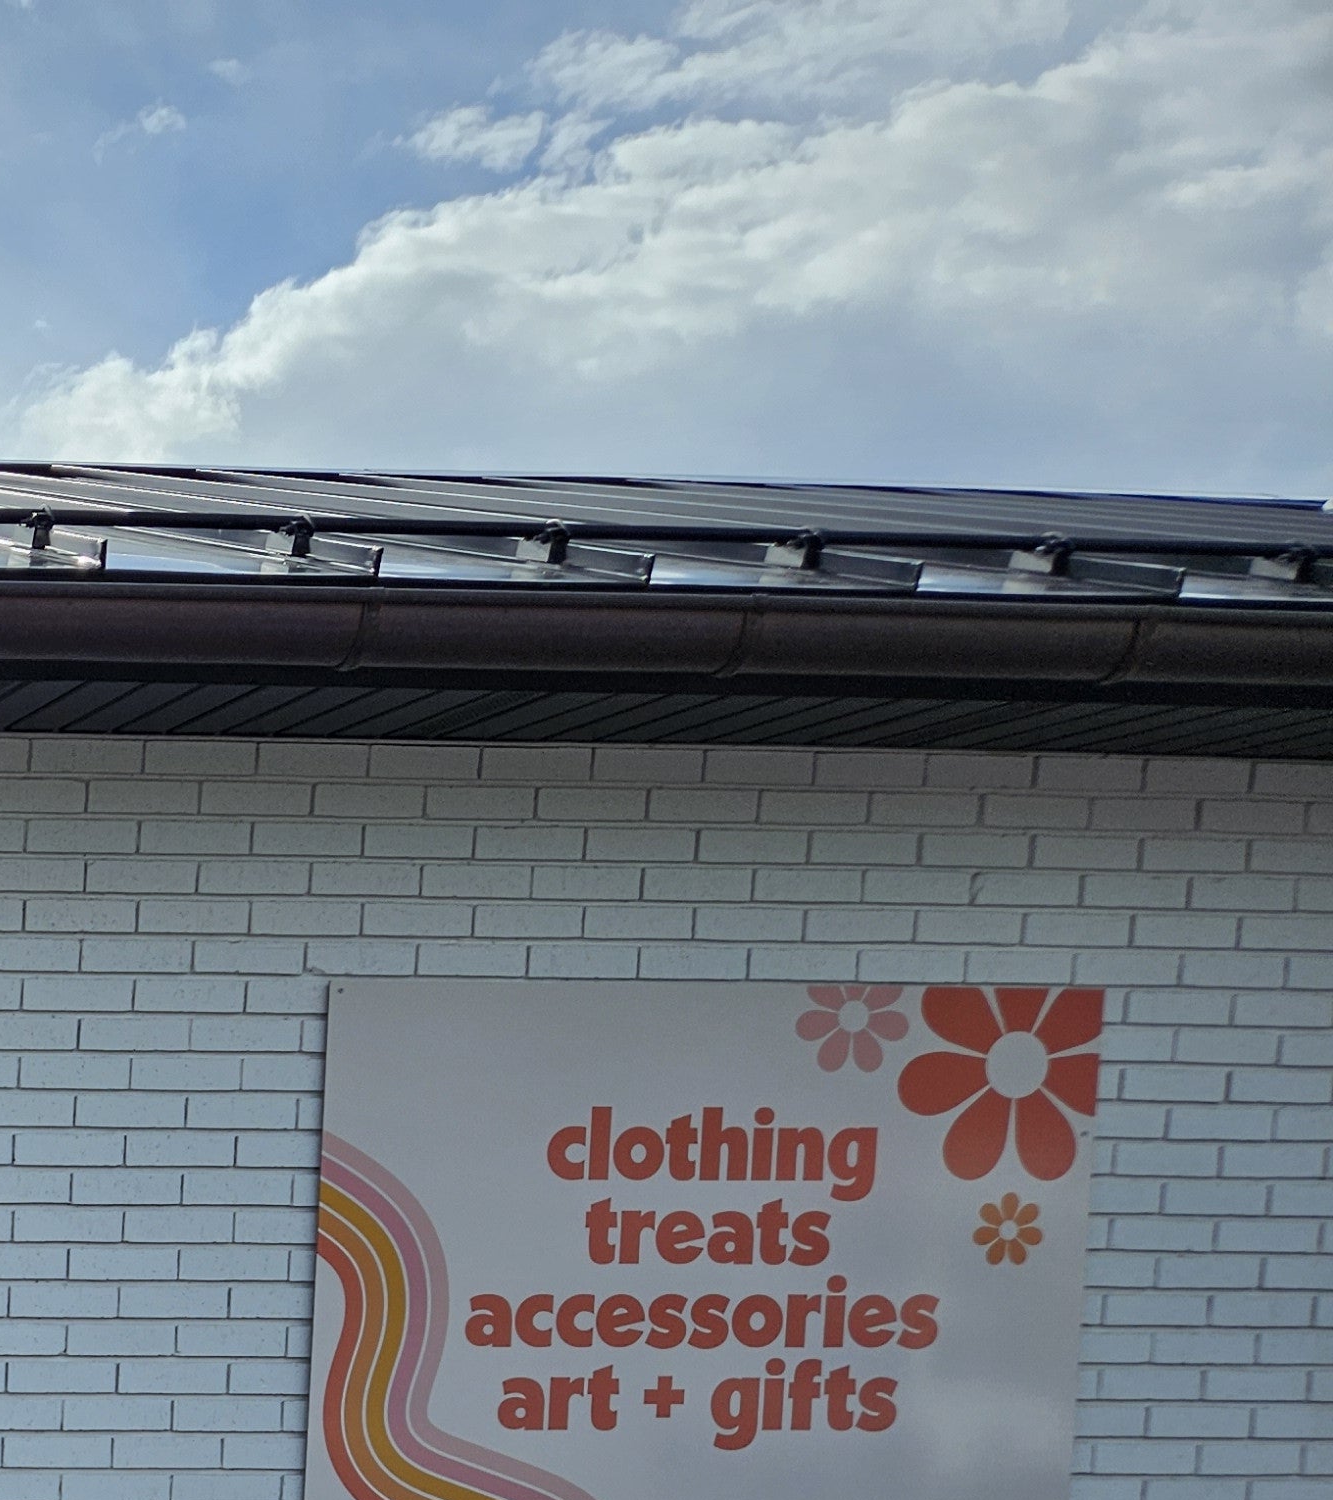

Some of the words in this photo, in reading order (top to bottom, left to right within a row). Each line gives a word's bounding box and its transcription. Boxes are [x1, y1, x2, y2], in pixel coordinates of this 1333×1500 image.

[546, 1105, 878, 1202] clothing
[584, 1196, 831, 1266] treats
[464, 1275, 941, 1350] accessories
[496, 1363, 620, 1432] art
[644, 1374, 685, 1418] +
[711, 1357, 899, 1451] gifts
